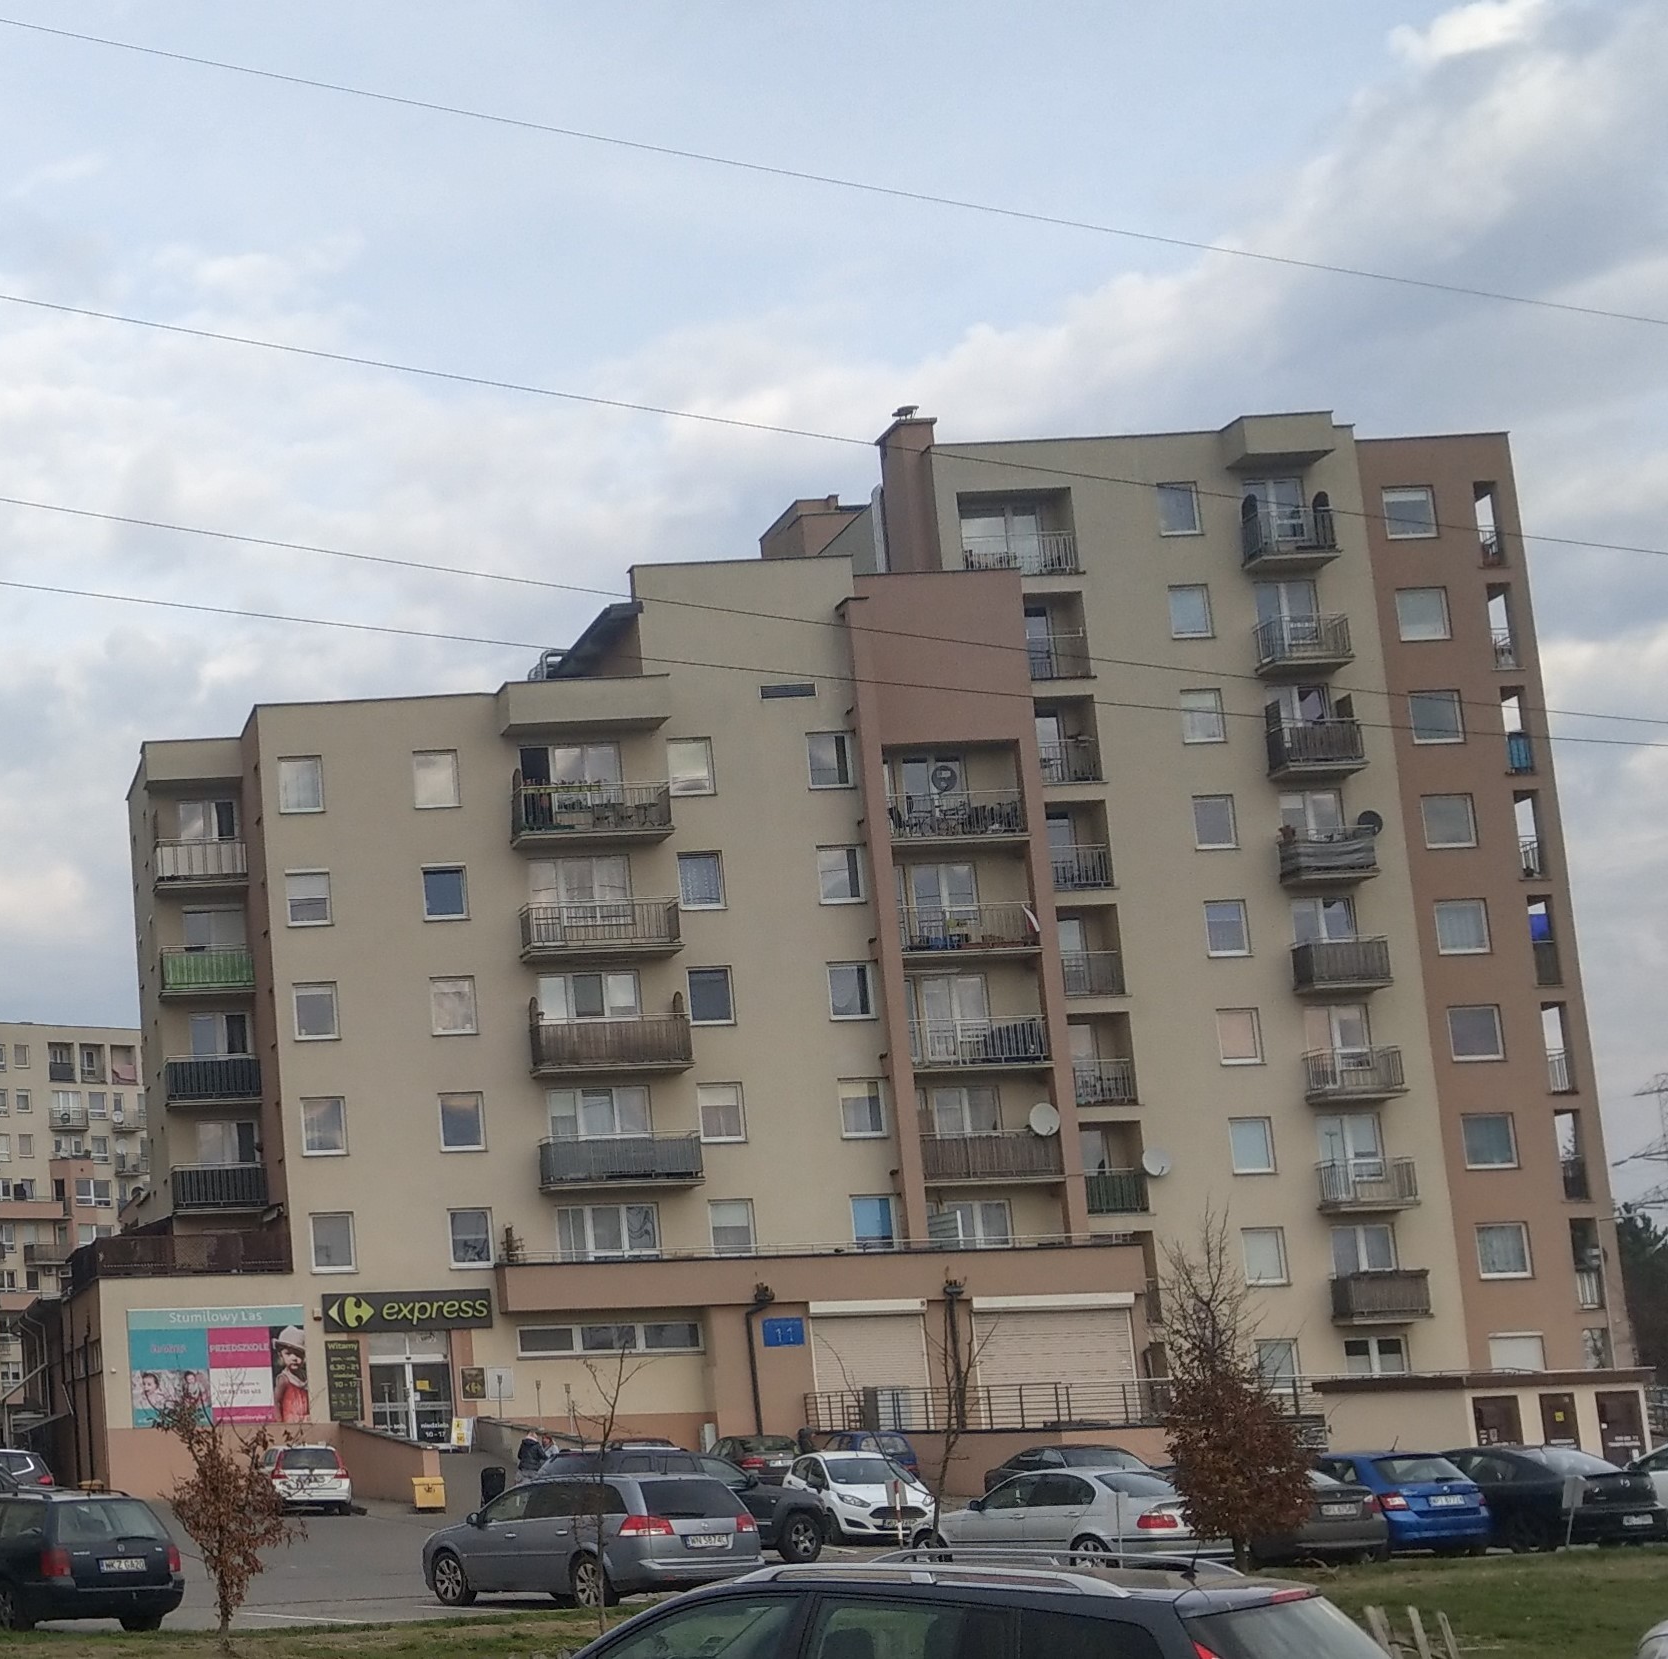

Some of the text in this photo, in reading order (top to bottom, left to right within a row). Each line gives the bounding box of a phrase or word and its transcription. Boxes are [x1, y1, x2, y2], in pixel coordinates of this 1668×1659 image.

[169, 1311, 262, 1324] Stumilowy Las
[383, 1300, 488, 1325] express
[776, 1327, 793, 1342] 11
[209, 1342, 270, 1352] PRZEDSZKOLE
